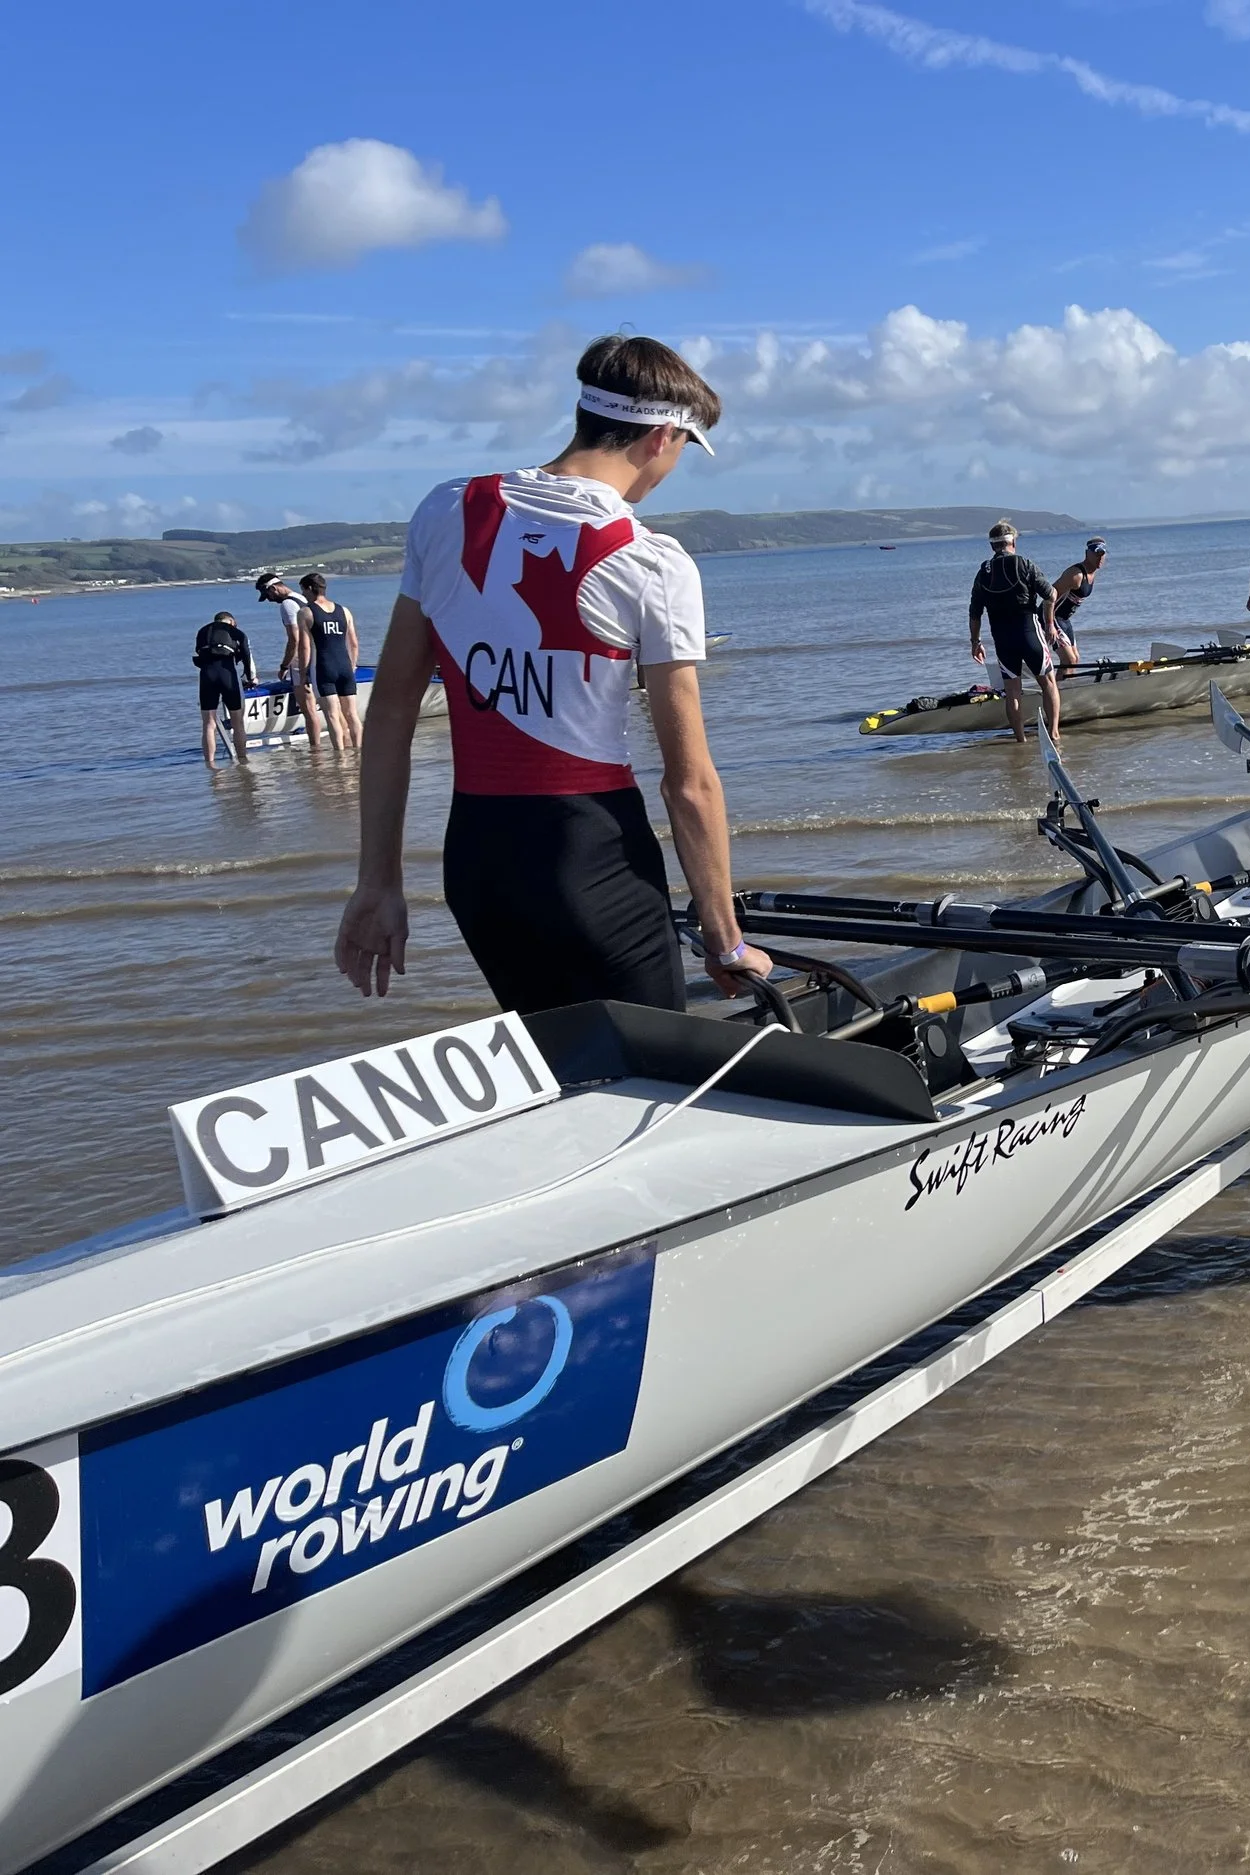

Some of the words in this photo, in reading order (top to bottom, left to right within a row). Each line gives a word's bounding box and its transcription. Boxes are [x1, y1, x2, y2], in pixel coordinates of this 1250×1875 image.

[323, 621, 343, 635] IRL
[247, 695, 285, 720] 415
[465, 641, 553, 718] CAN
[196, 1019, 545, 1188] CAN01
[904, 1131, 989, 1211] Swift
[992, 1094, 1087, 1166] Racing
[204, 1400, 436, 1553] world
